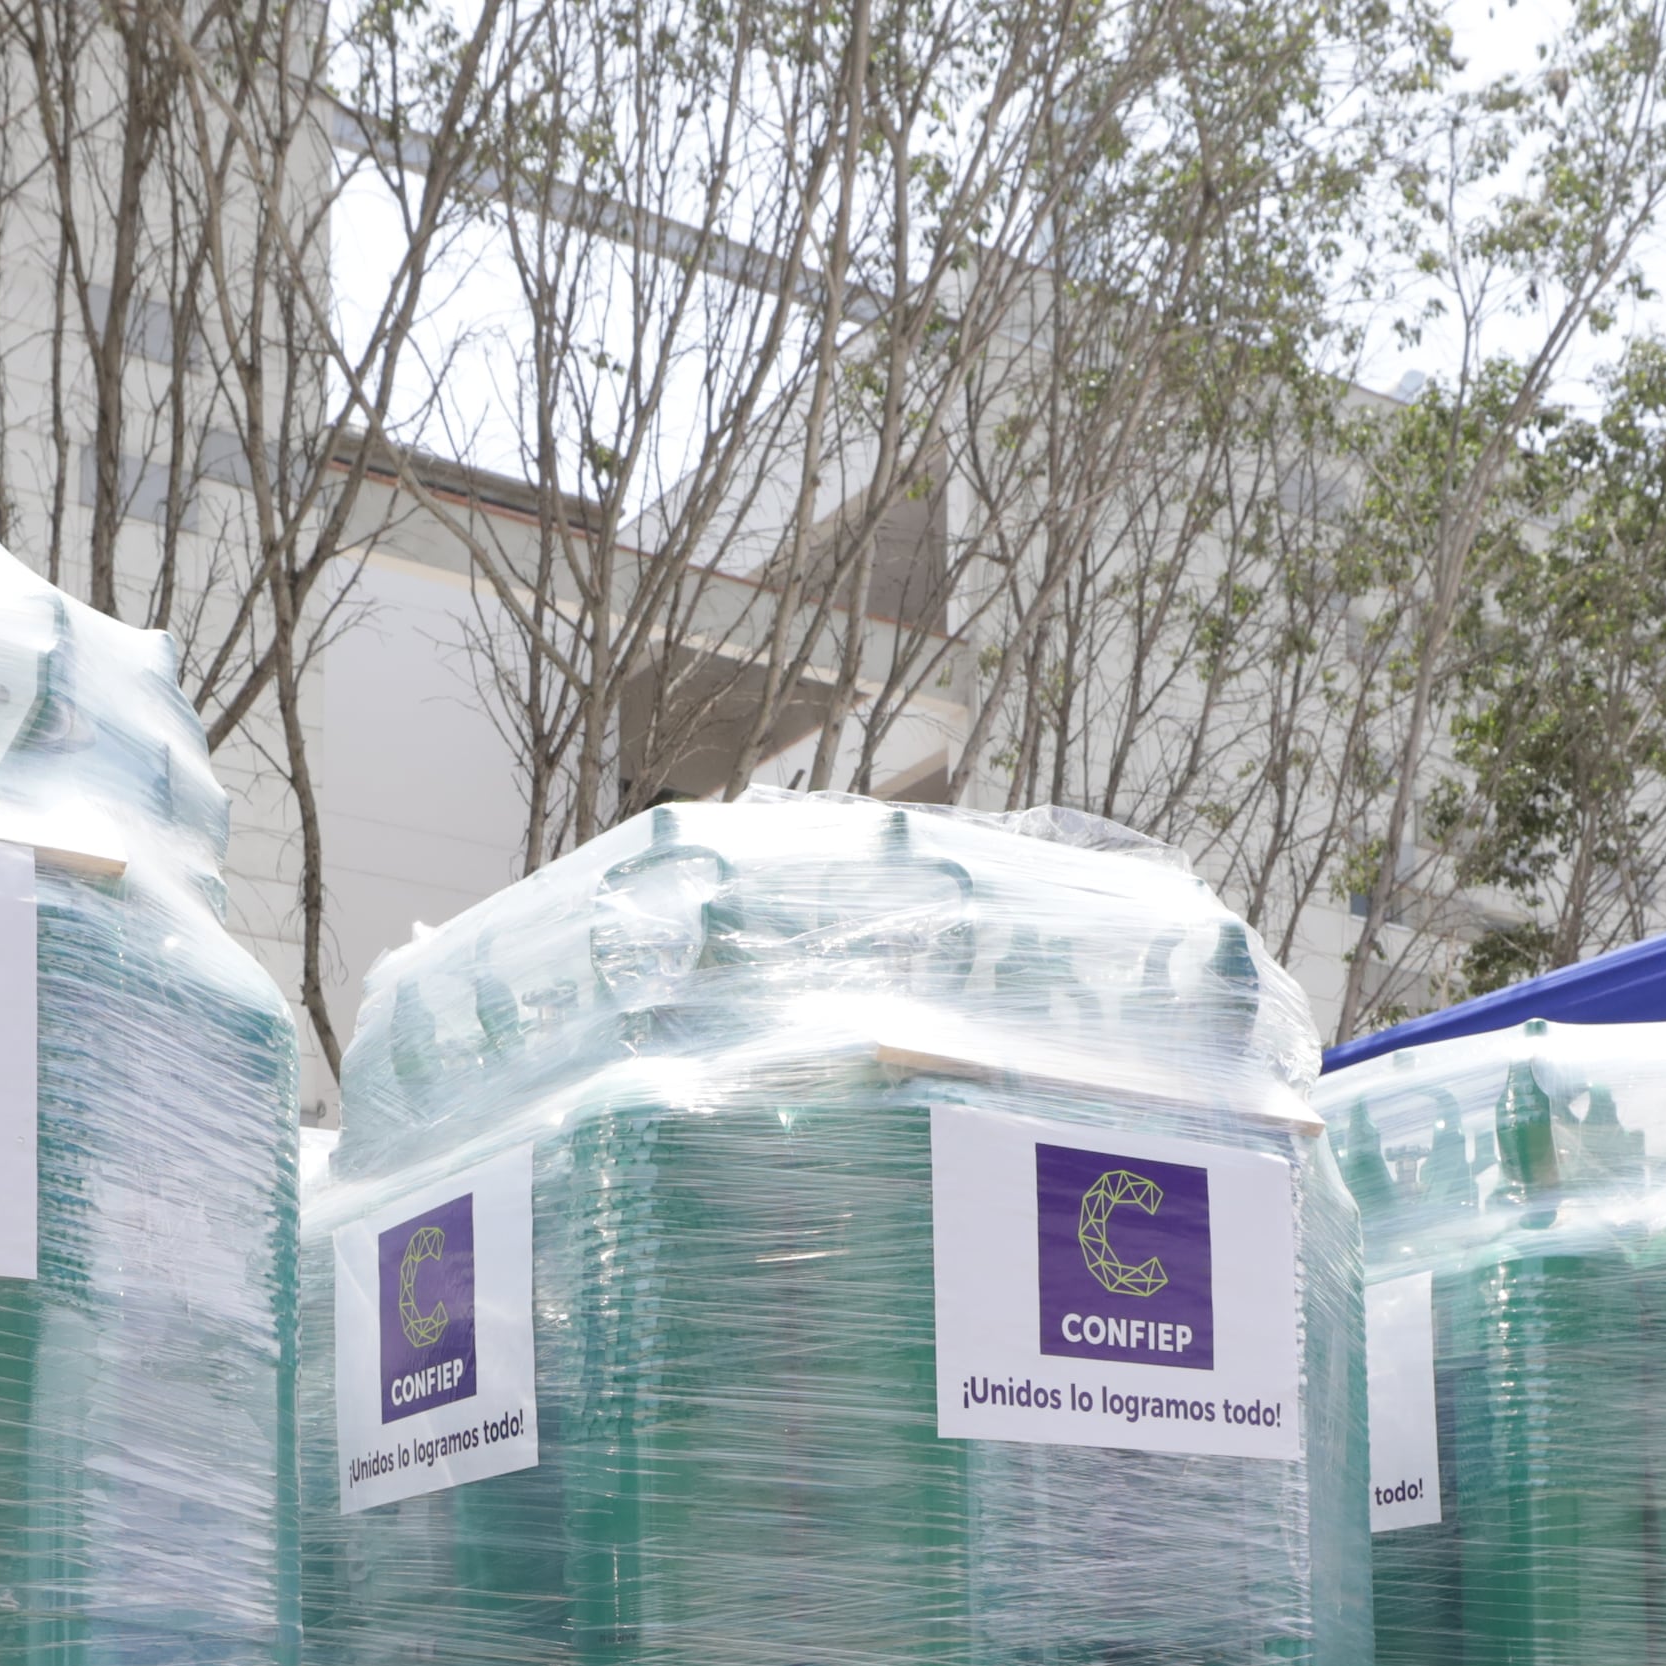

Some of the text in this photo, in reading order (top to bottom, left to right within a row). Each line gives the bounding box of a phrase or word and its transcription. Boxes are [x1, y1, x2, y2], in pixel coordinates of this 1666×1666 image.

[1061, 1313, 1192, 1352] CONFIEP
[391, 1358, 463, 1406] CONFIEP
[963, 1376, 1281, 1427] ¡Unidos lo logramos todo!
[349, 1409, 524, 1488] ¡Unidos lo logramos todo!
[1375, 1478, 1423, 1505] todo!
